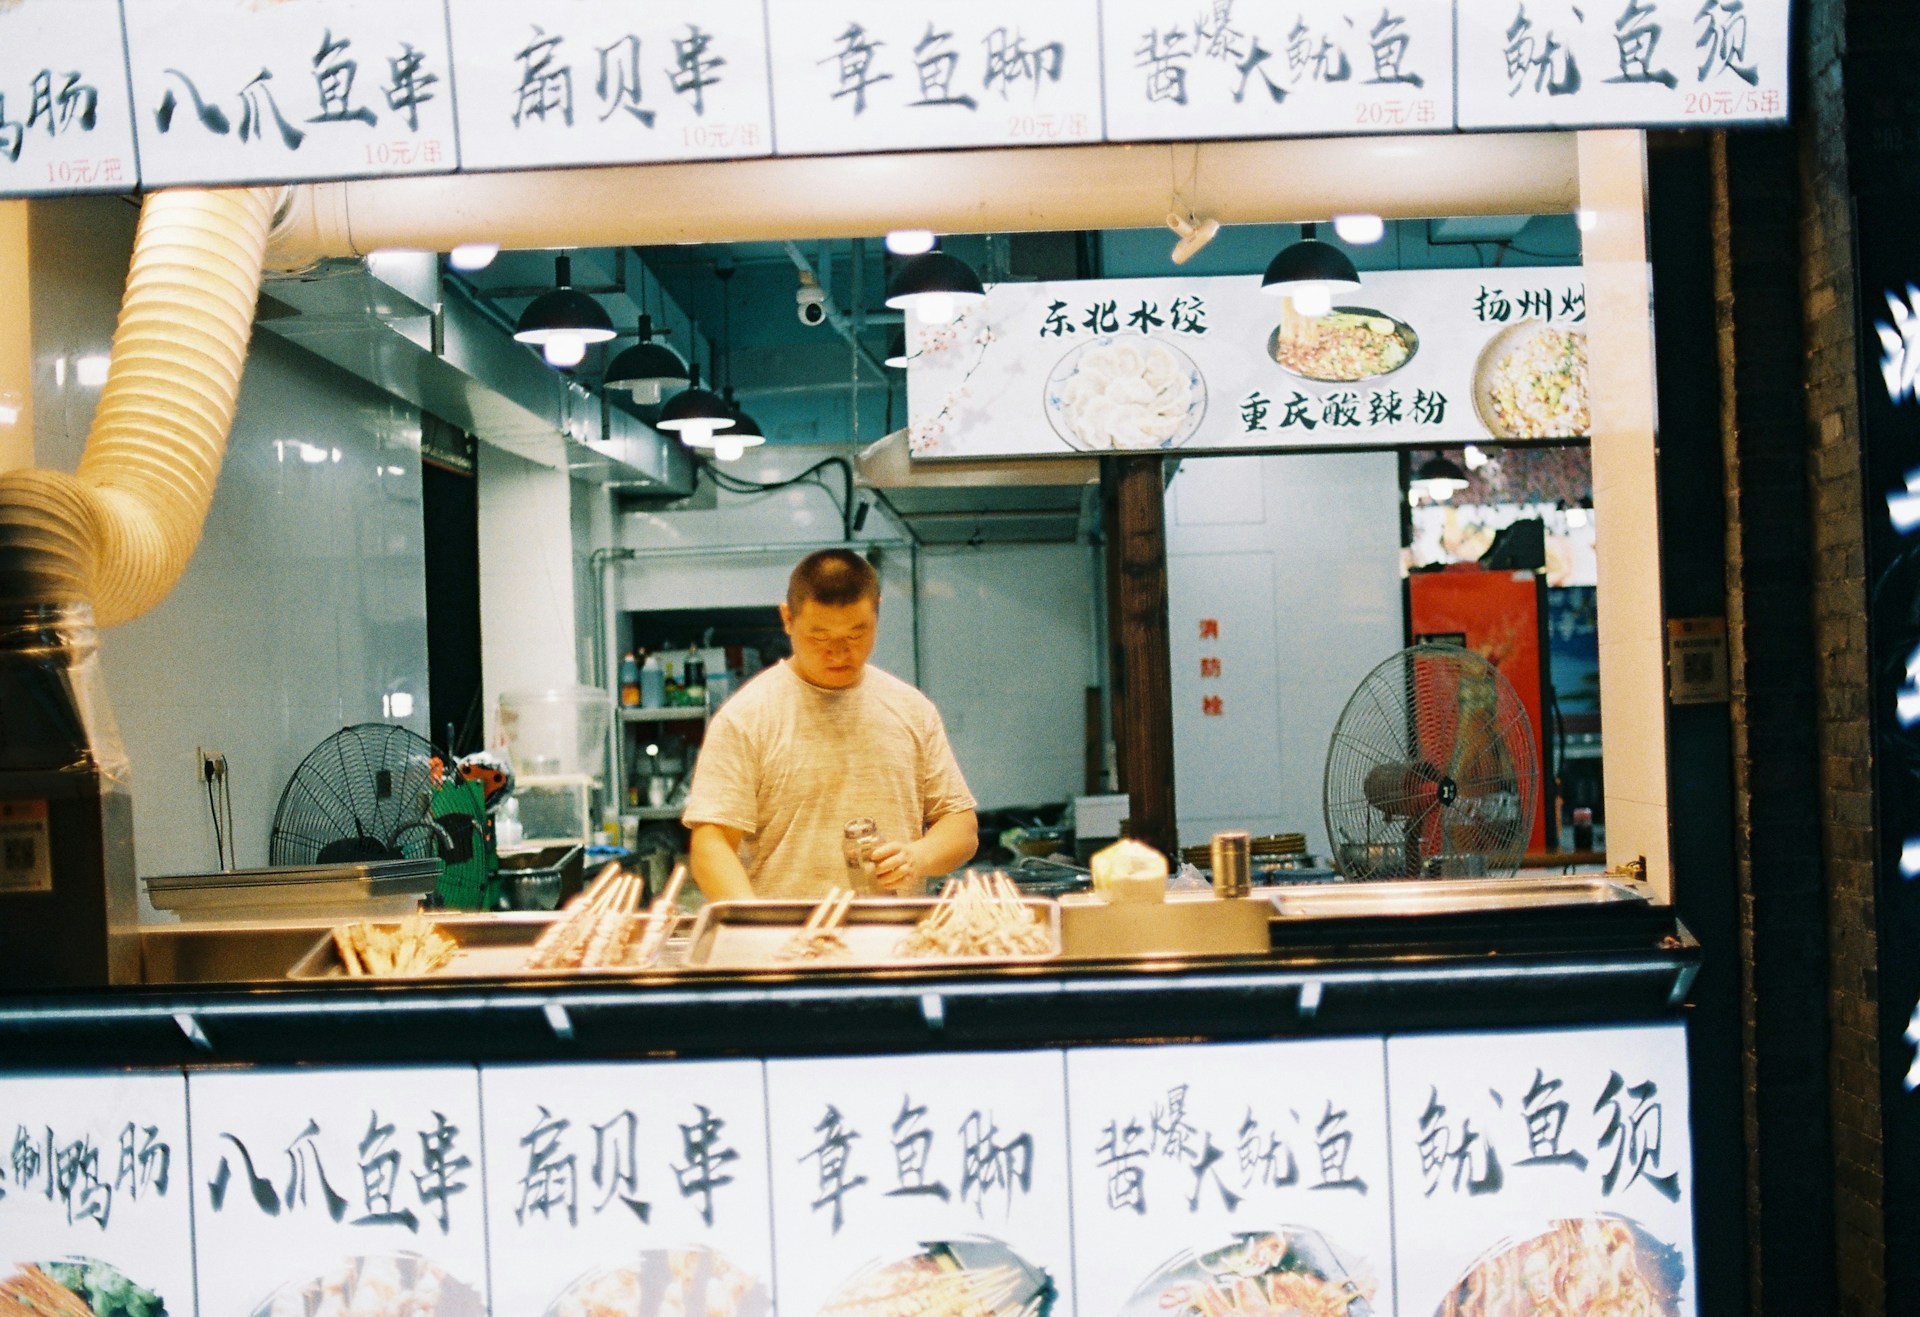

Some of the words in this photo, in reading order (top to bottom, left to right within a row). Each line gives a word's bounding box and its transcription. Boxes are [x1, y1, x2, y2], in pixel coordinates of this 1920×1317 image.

[153, 28, 439, 151] 八爪鱼串
[512, 24, 728, 129] 扇贝串
[816, 23, 1065, 116] 章鱼脚
[1135, 0, 1424, 106] 酱爆大鱿鱼
[1502, 0, 1759, 98] 鱿鱼须
[681, 123, 761, 149] 10元/串
[1008, 113, 1089, 140] 20元/串
[1356, 100, 1435, 125] 20元/串
[1684, 89, 1780, 117] 20元/5串
[46, 158, 123, 184] 10元/把
[364, 140, 443, 166] 10元/串
[1039, 295, 1209, 338] 东北水饺
[1239, 389, 1448, 433] 重庆酸辣粉
[0, 1120, 171, 1231] 制鸭肠
[207, 1110, 473, 1234] 八爪鱼串
[515, 1103, 739, 1228] 扇贝串
[798, 1094, 1034, 1235] 章鱼脚
[1095, 1083, 1368, 1216] 酱爆大鱿鱼
[1415, 1067, 1682, 1204] 鱿鱼须
